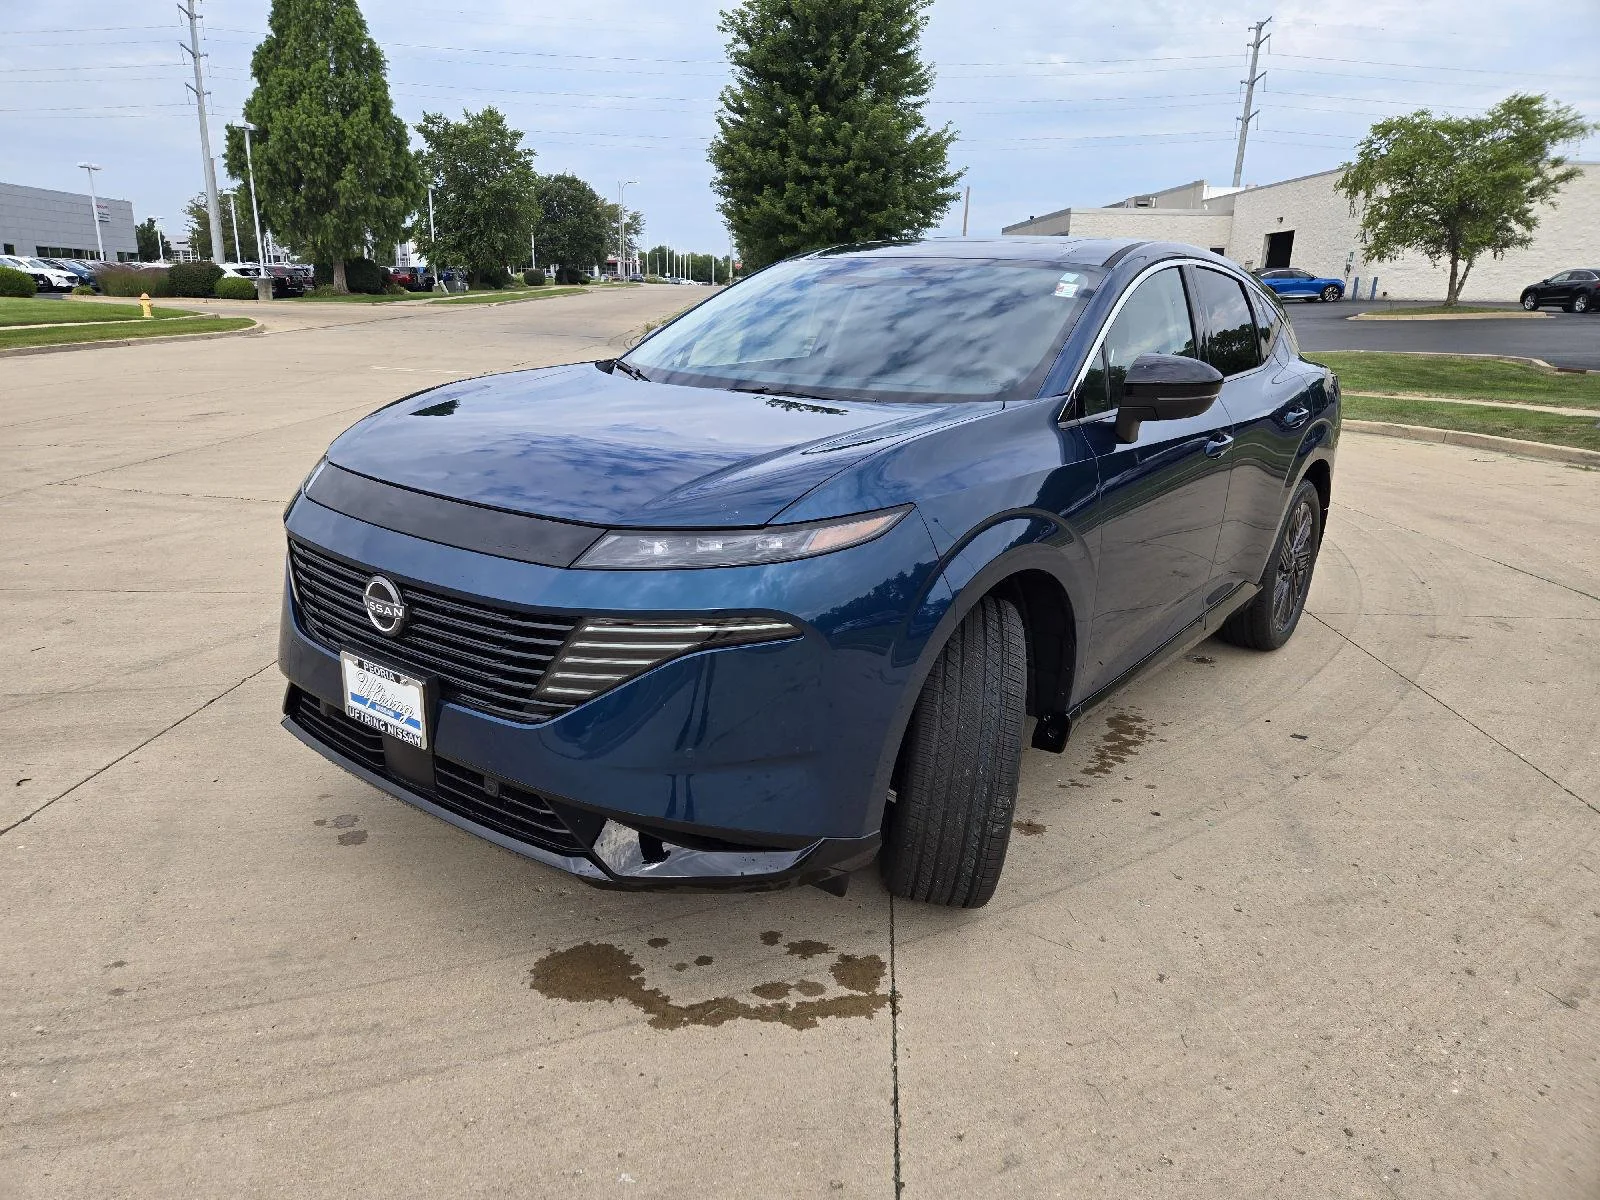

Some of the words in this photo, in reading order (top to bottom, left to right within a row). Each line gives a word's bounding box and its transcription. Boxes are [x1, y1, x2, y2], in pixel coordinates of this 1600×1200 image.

[364, 599, 402, 617] ISSAN
[363, 662, 396, 682] PEORIA
[348, 705, 386, 731] UFTRING
[387, 723, 421, 748] NISSAN
